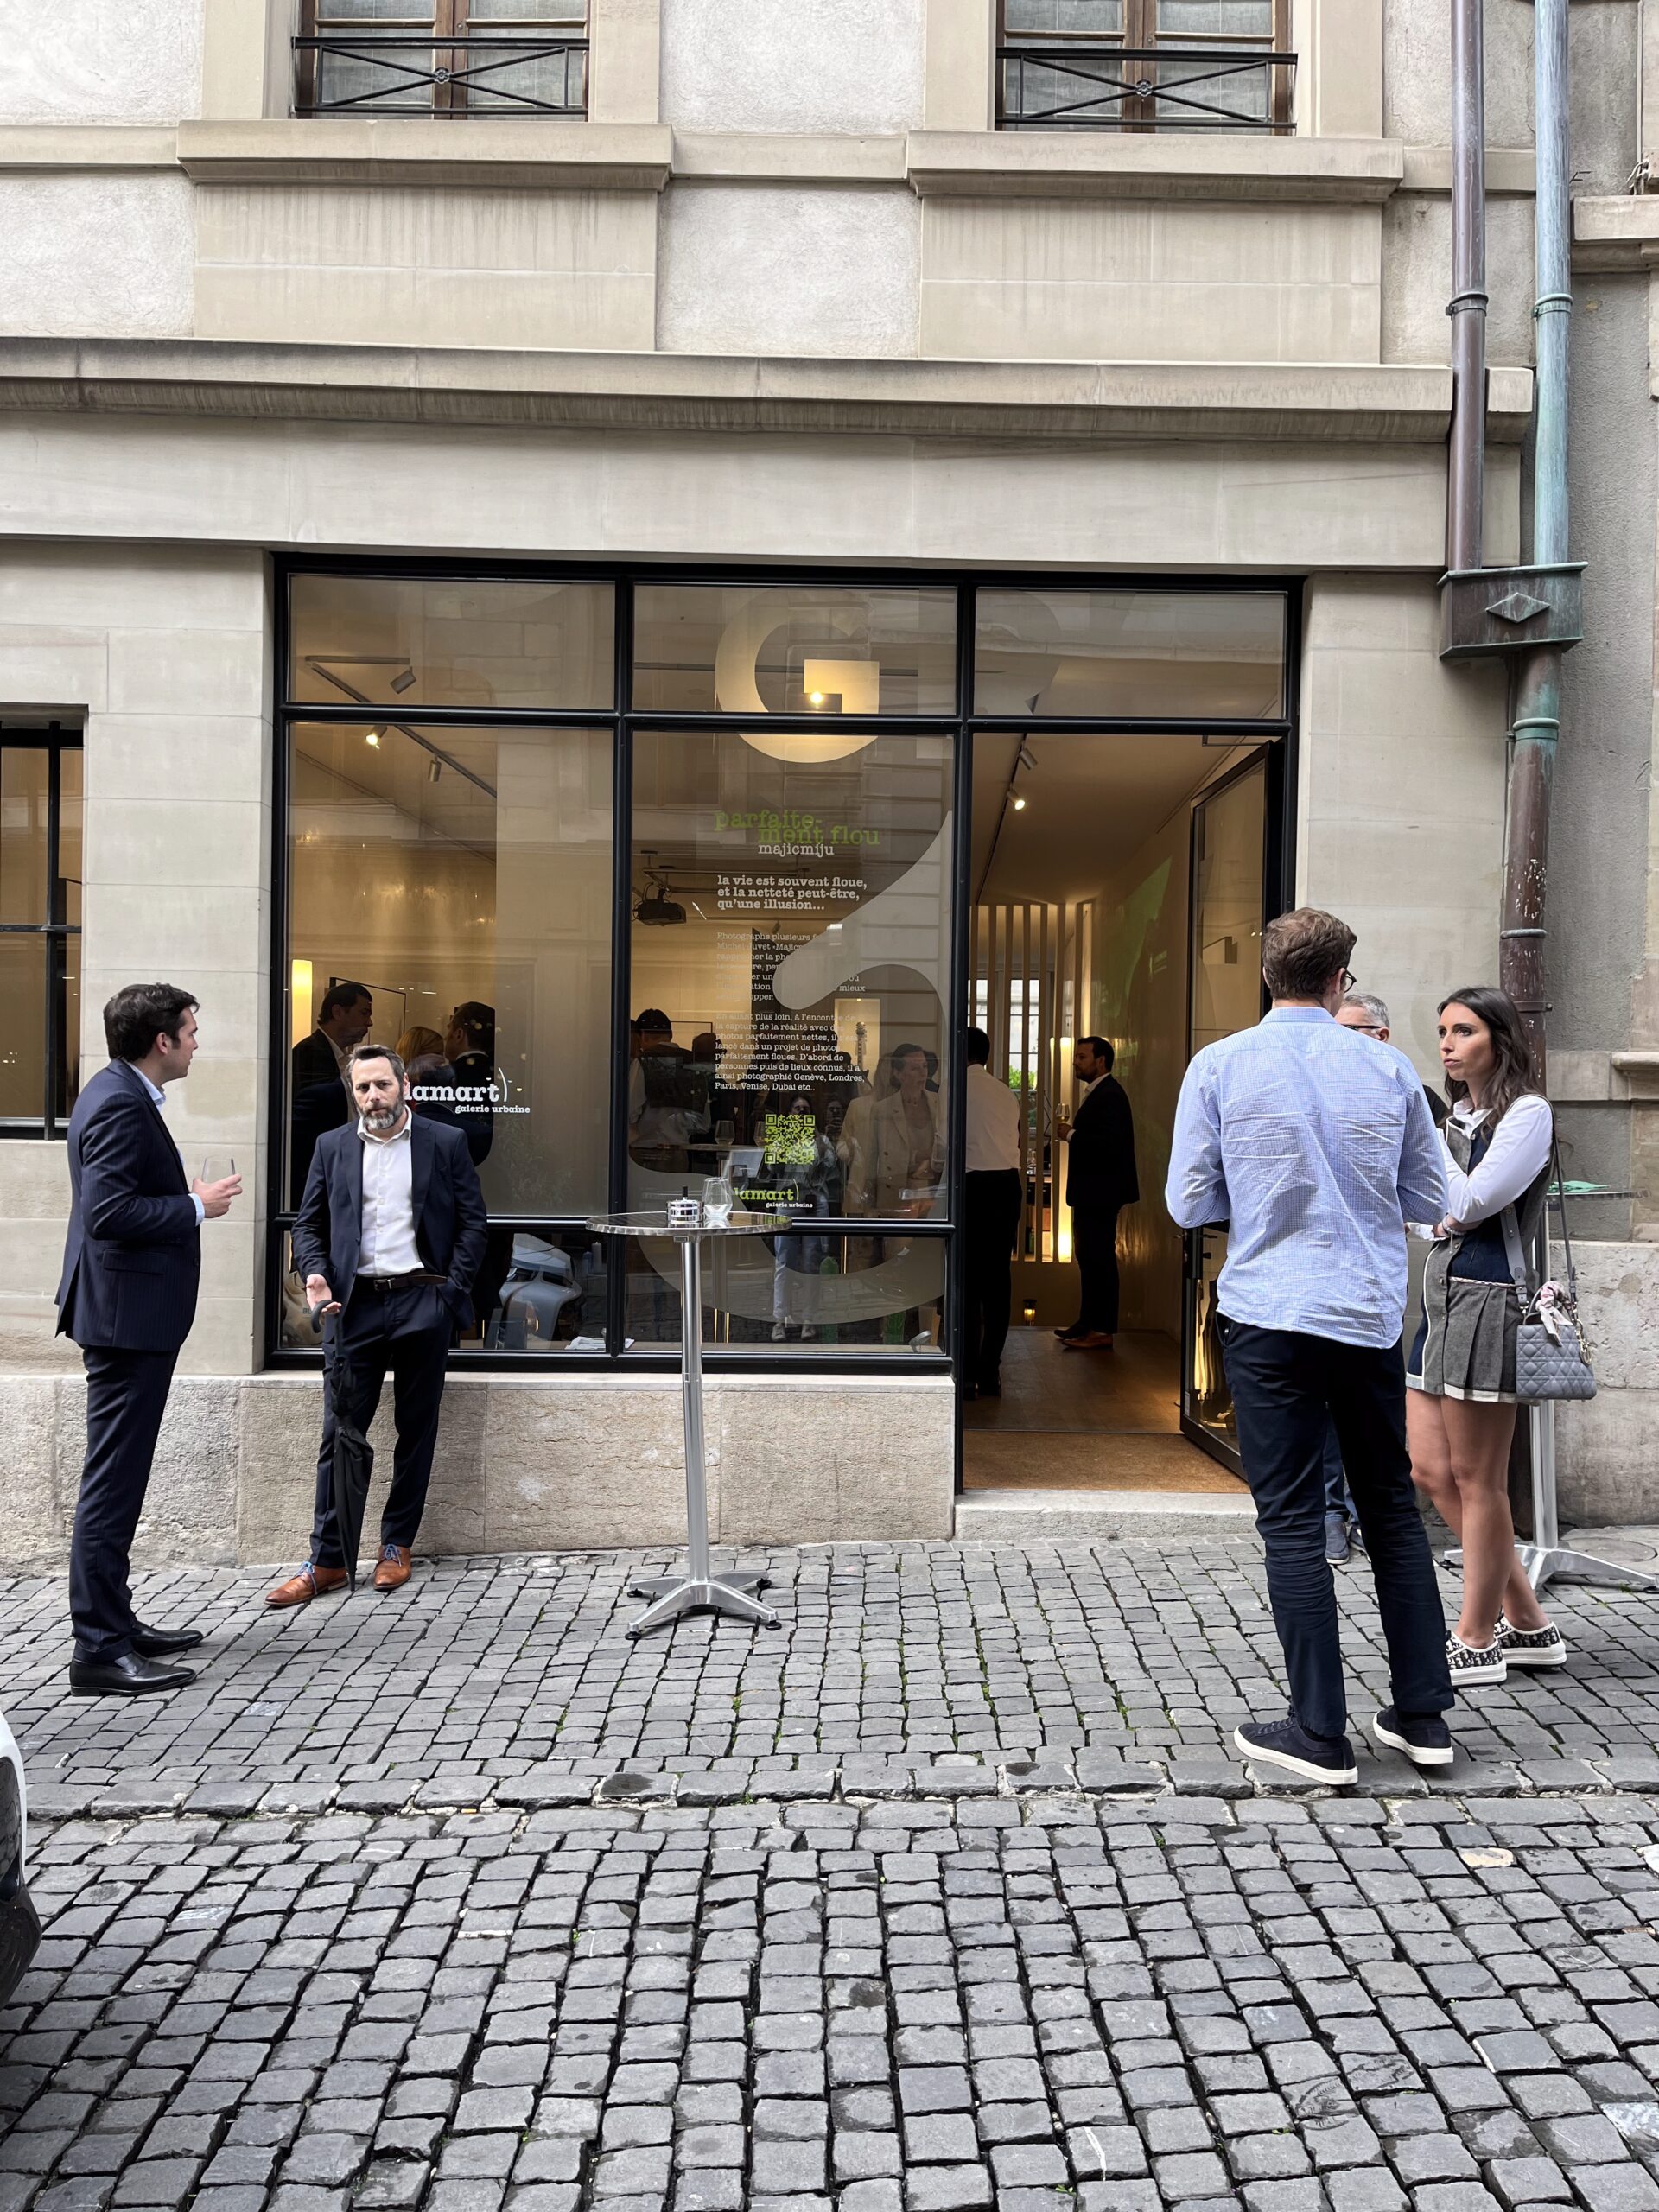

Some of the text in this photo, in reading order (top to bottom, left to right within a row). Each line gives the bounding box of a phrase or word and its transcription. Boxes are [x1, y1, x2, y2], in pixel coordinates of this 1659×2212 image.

[714, 810, 823, 831] parfaite-
[759, 825, 880, 845] ment flou
[717, 875, 868, 890] la vie est souvent floue,
[717, 887, 860, 901] et la netteté peut-être,
[764, 899, 824, 910] illusion...
[772, 933, 810, 942] plusieurs
[736, 1072, 792, 1081] photographié
[794, 1073, 827, 1082] Genève,
[715, 1082, 739, 1090] Paris,
[741, 1082, 770, 1090] Venise,
[454, 1104, 531, 1114] galerie urbaine
